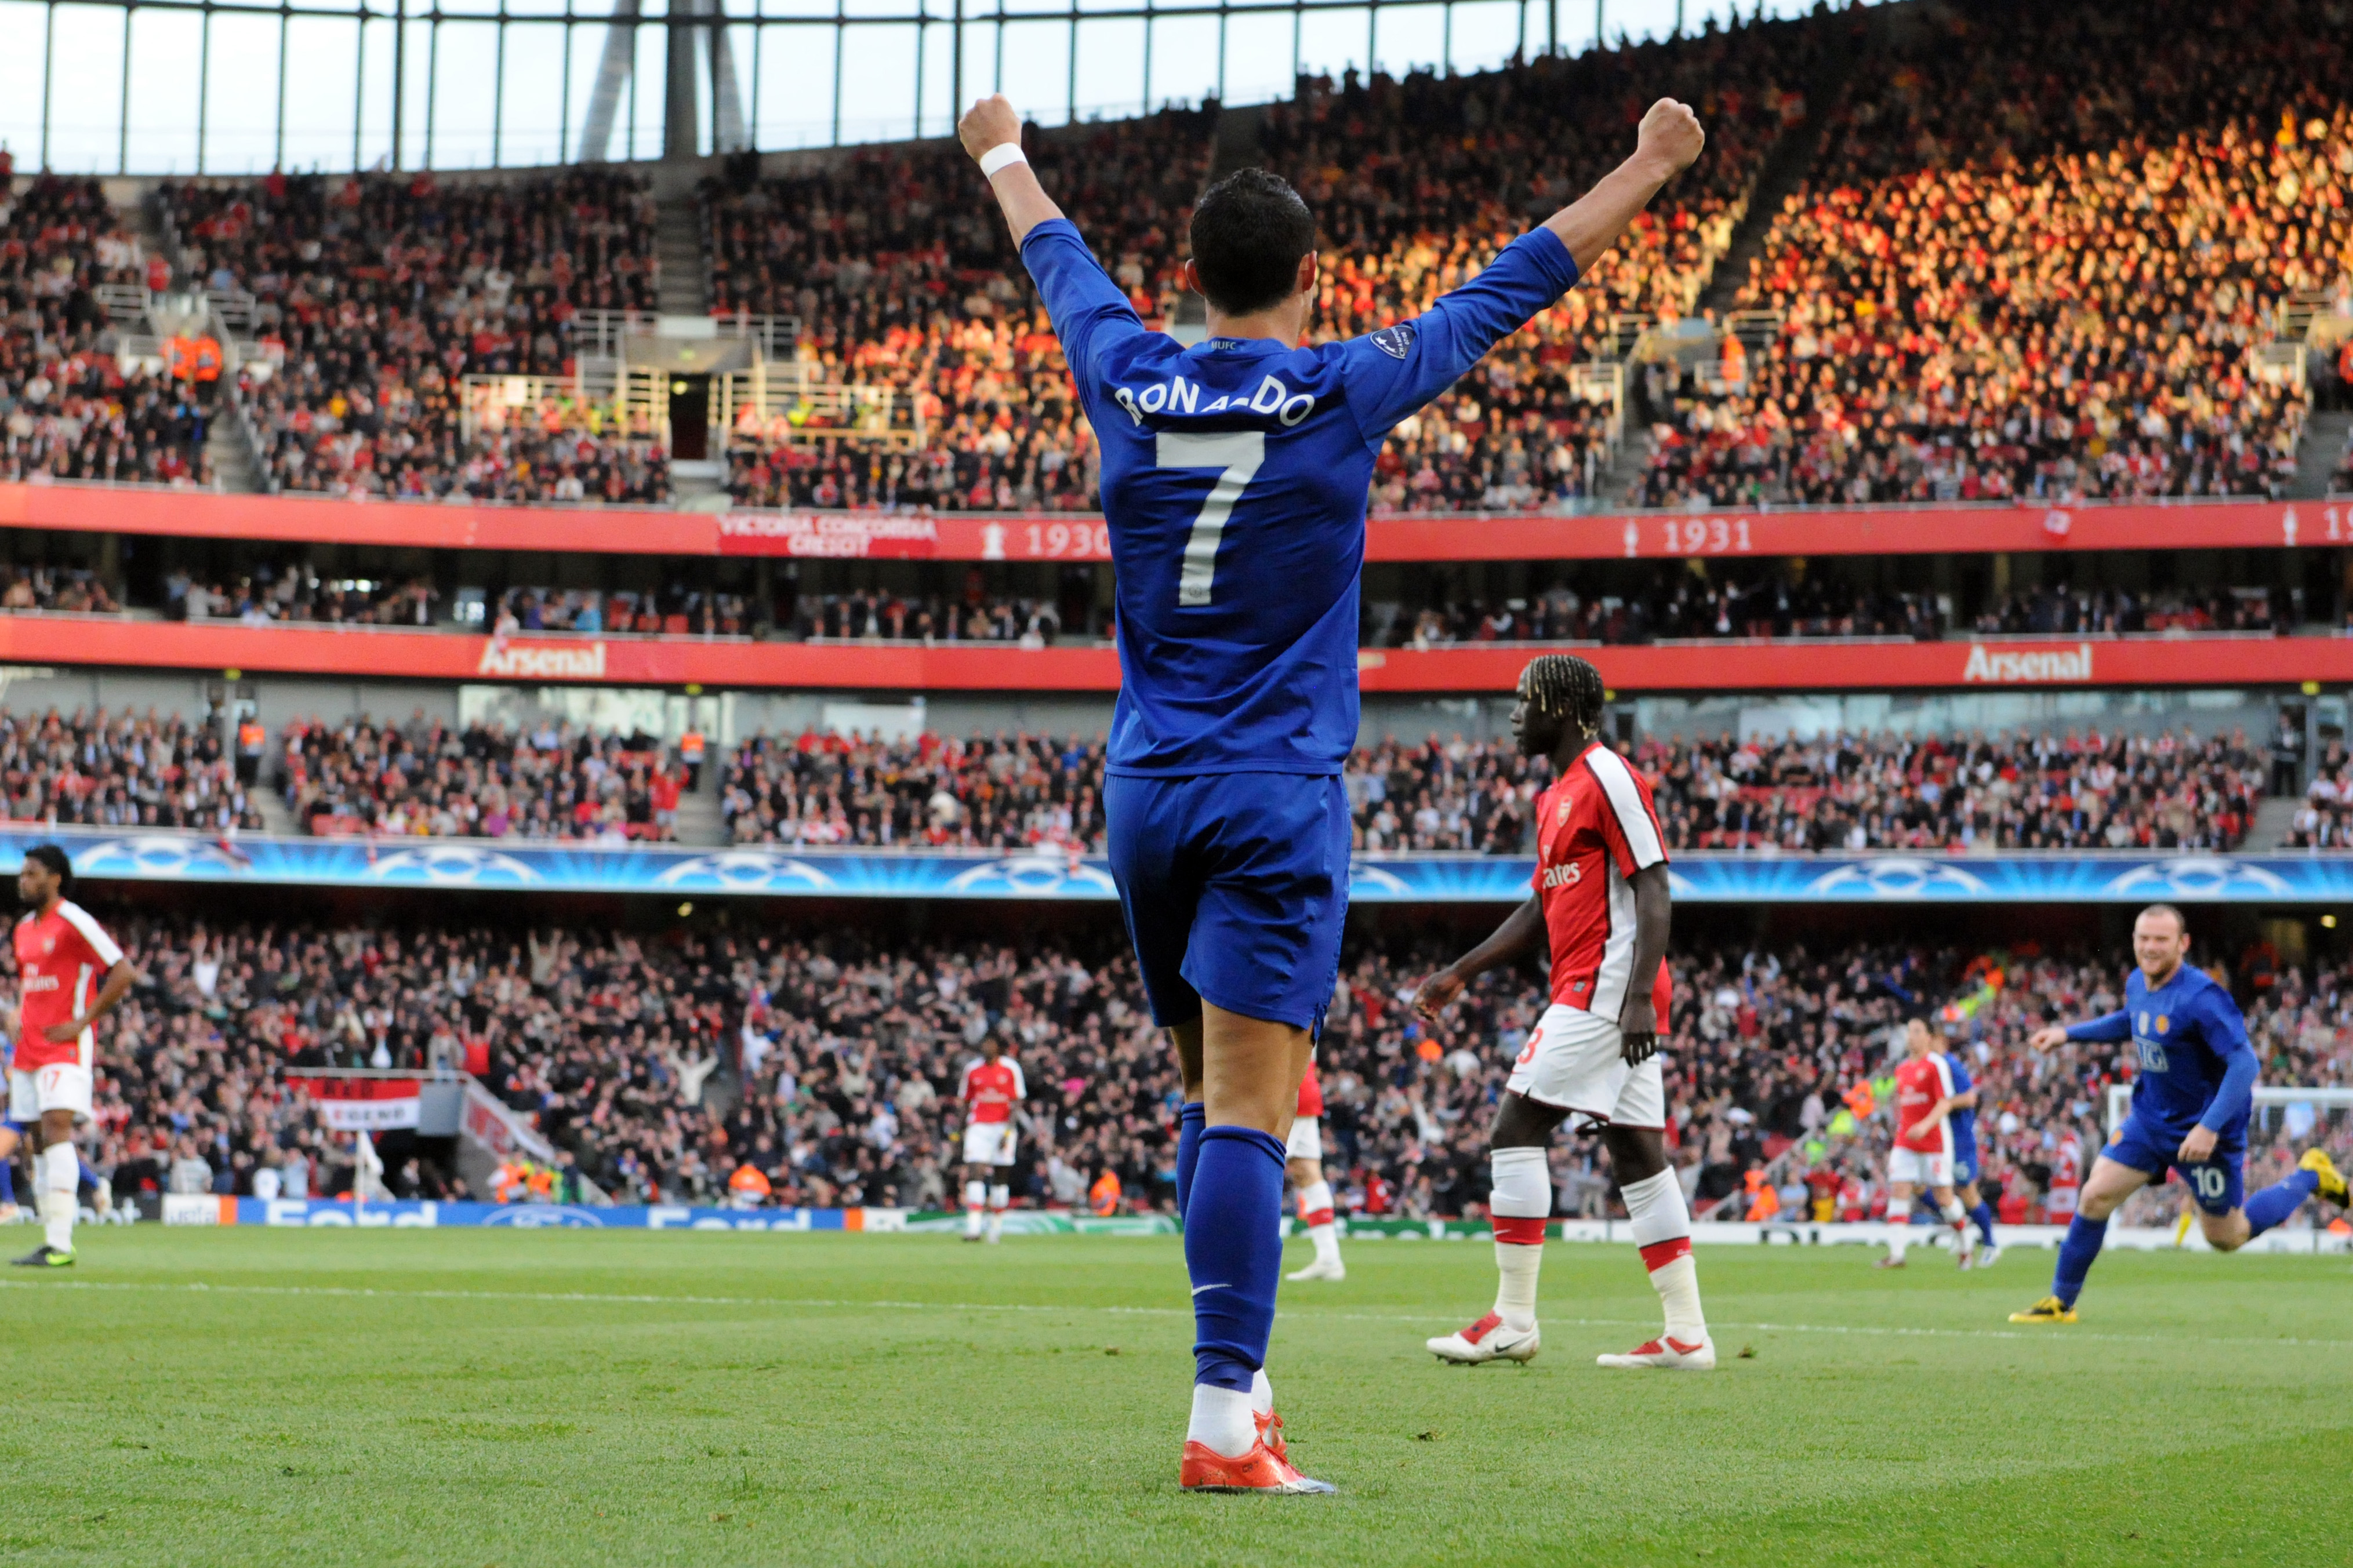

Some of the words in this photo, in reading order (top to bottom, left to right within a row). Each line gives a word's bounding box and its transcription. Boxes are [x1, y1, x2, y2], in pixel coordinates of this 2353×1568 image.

[1211, 341, 1236, 350] MUFC
[1156, 431, 1265, 606] 7
[1664, 518, 1752, 553] 1931
[1026, 523, 1112, 557] 1930
[478, 638, 606, 677] Arsenal
[1963, 643, 2092, 681] Arsenal
[1542, 862, 1581, 889] ates
[43, 1069, 61, 1092] 17
[2191, 1166, 2225, 1199] 10
